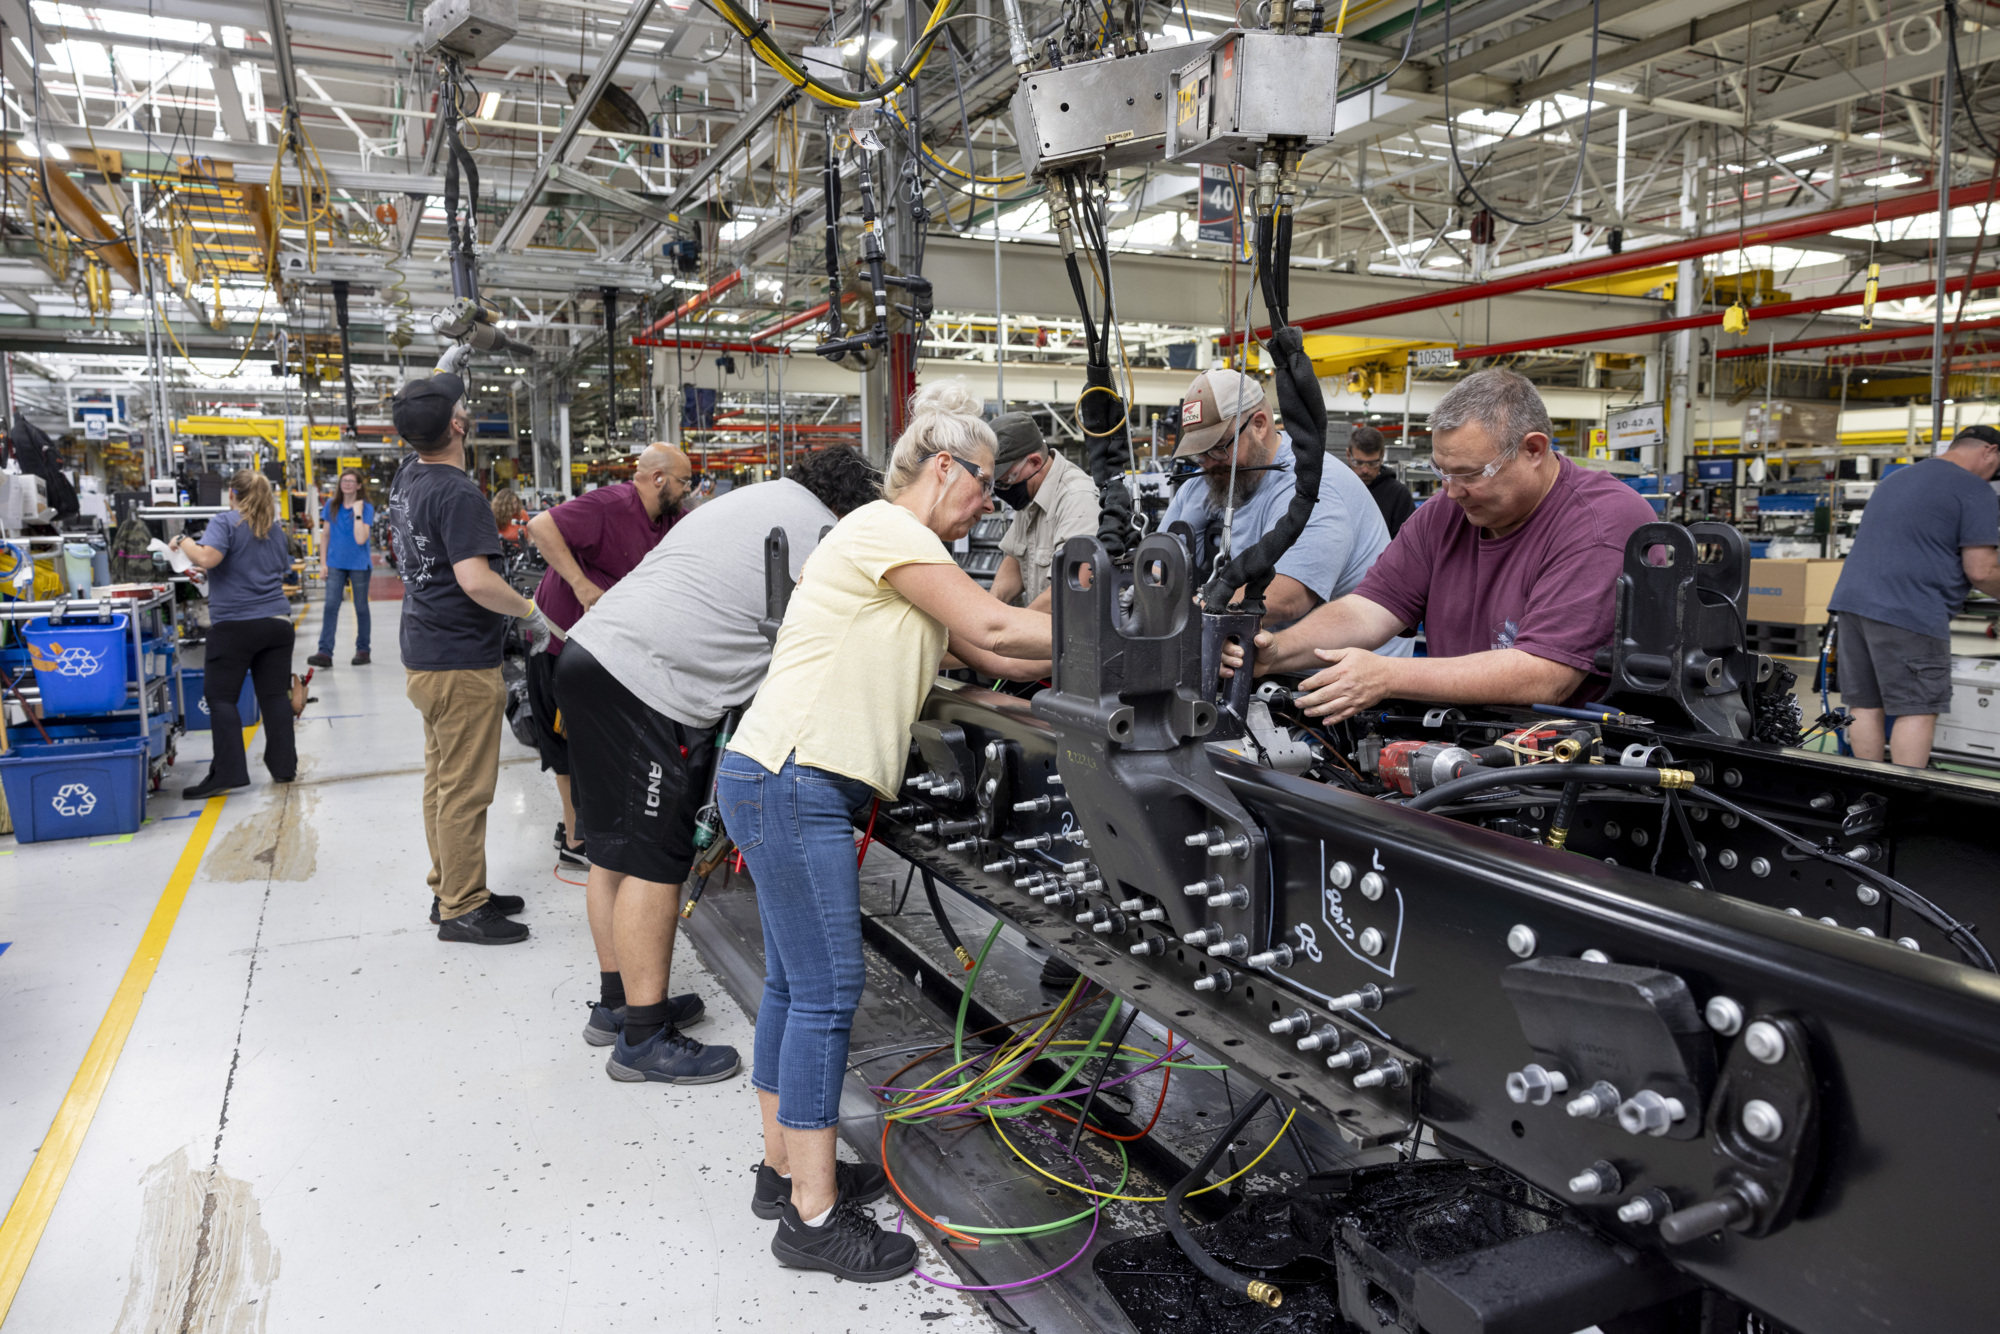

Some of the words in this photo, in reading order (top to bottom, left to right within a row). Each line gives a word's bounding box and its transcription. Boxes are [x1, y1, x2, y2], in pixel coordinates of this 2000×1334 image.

[1179, 83, 1196, 122] H-6
[1209, 184, 1234, 212] 40
[1419, 350, 1451, 365] 1052H
[1616, 419, 1644, 430] 10-42
[1646, 418, 1654, 426] A
